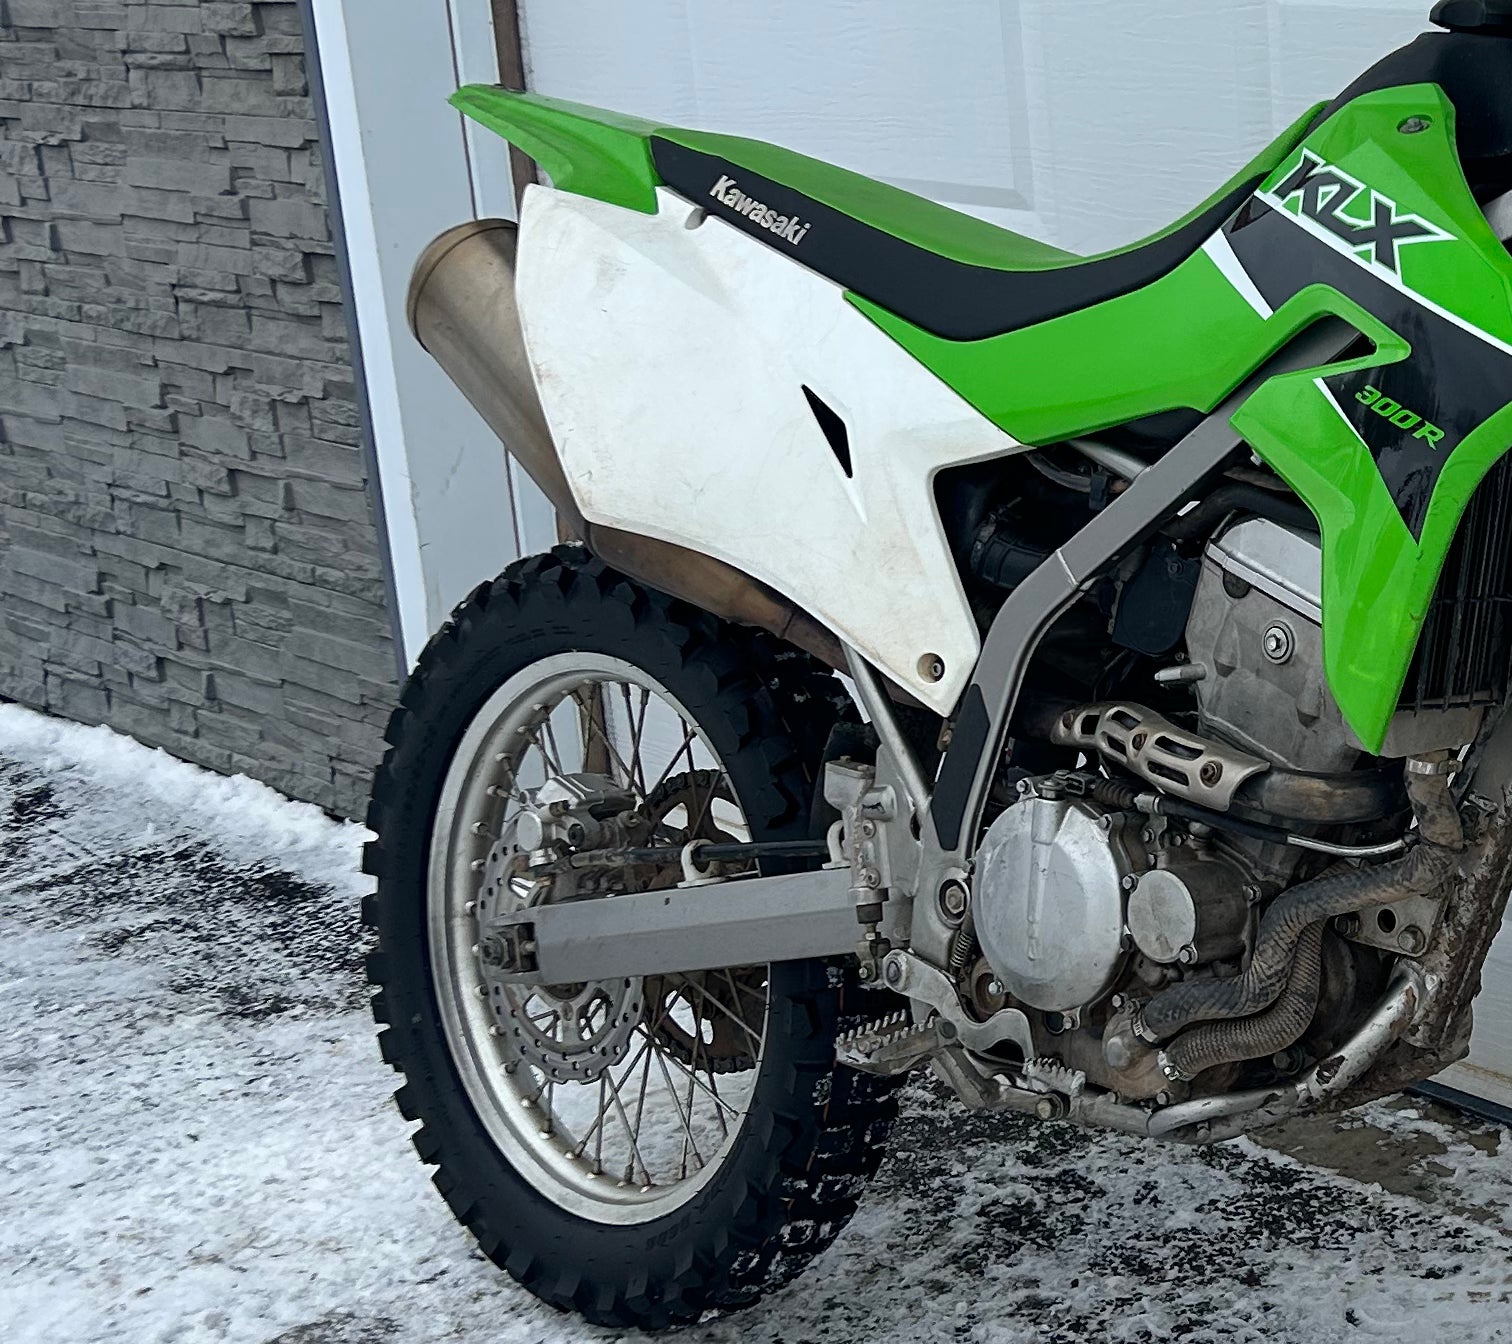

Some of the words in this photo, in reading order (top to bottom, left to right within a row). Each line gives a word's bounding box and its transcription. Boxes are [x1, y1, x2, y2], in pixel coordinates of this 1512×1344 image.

[709, 174, 812, 246] Kawasaki
[1274, 147, 1459, 285] KLX
[1354, 384, 1446, 452] 300R
